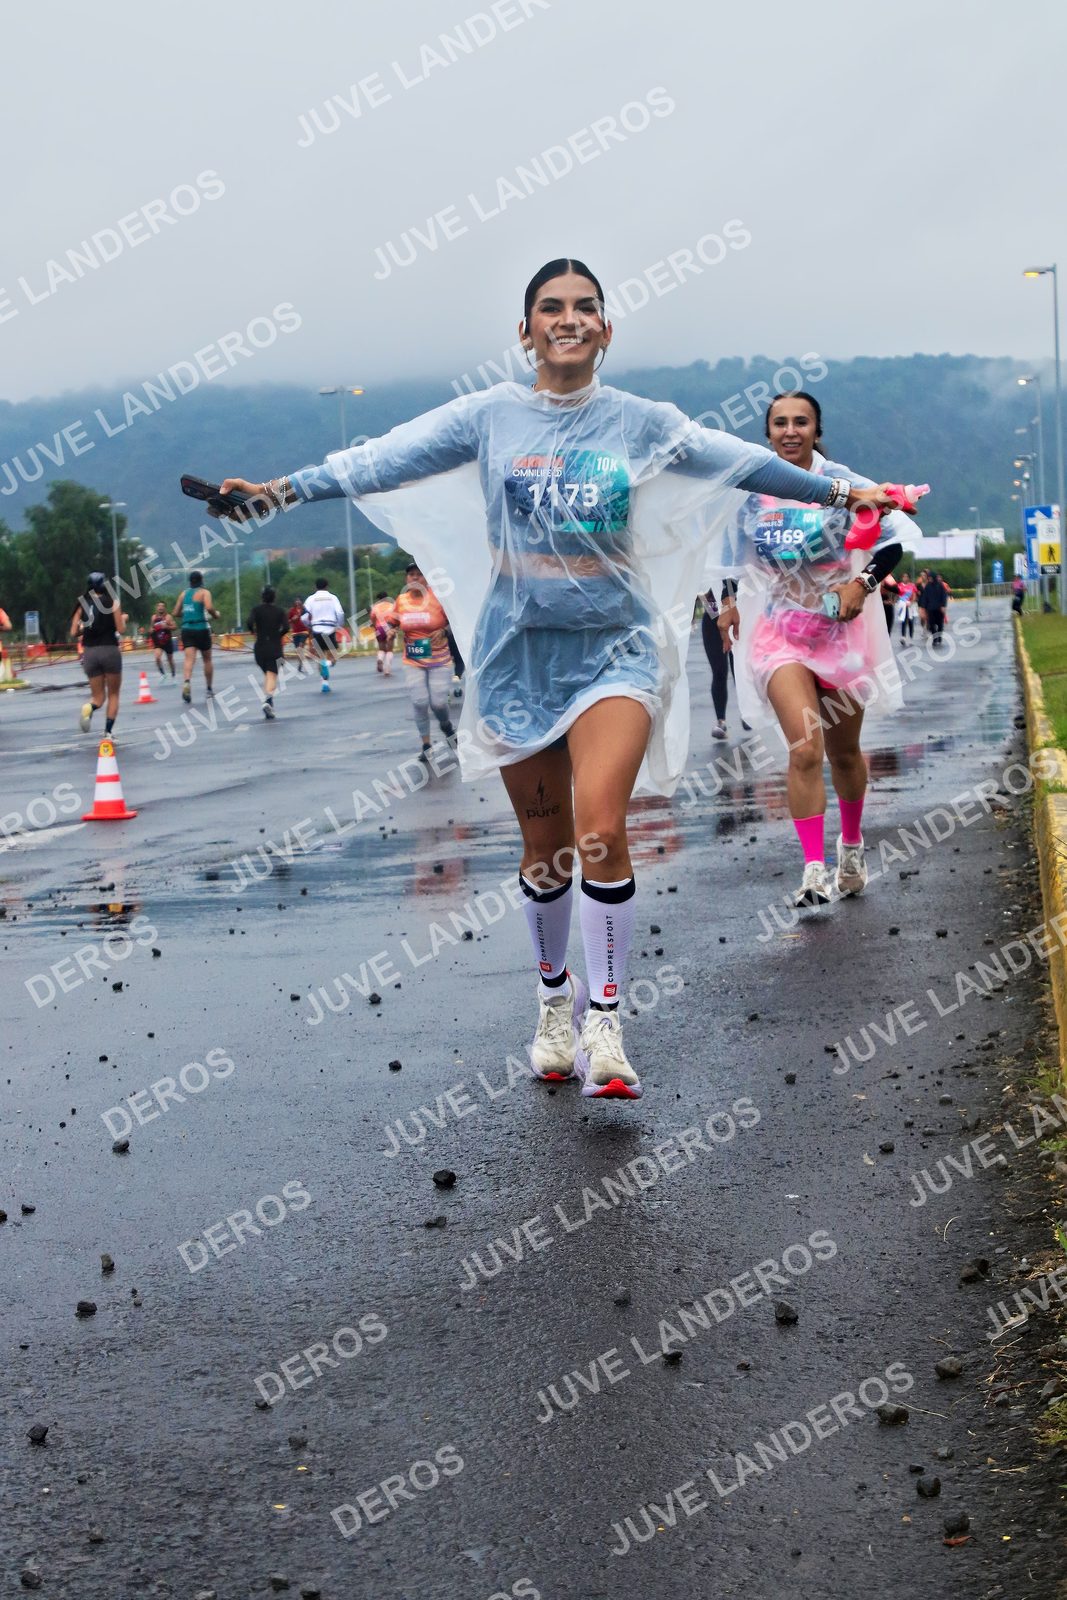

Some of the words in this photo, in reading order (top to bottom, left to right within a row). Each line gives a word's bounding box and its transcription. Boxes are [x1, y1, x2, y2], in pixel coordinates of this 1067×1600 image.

[597, 456, 618, 472] 10K
[528, 483, 599, 507] 1173
[763, 529, 804, 544] 1169
[407, 646, 425, 654] 1166
[606, 915, 614, 982] COMPRESSPORT
